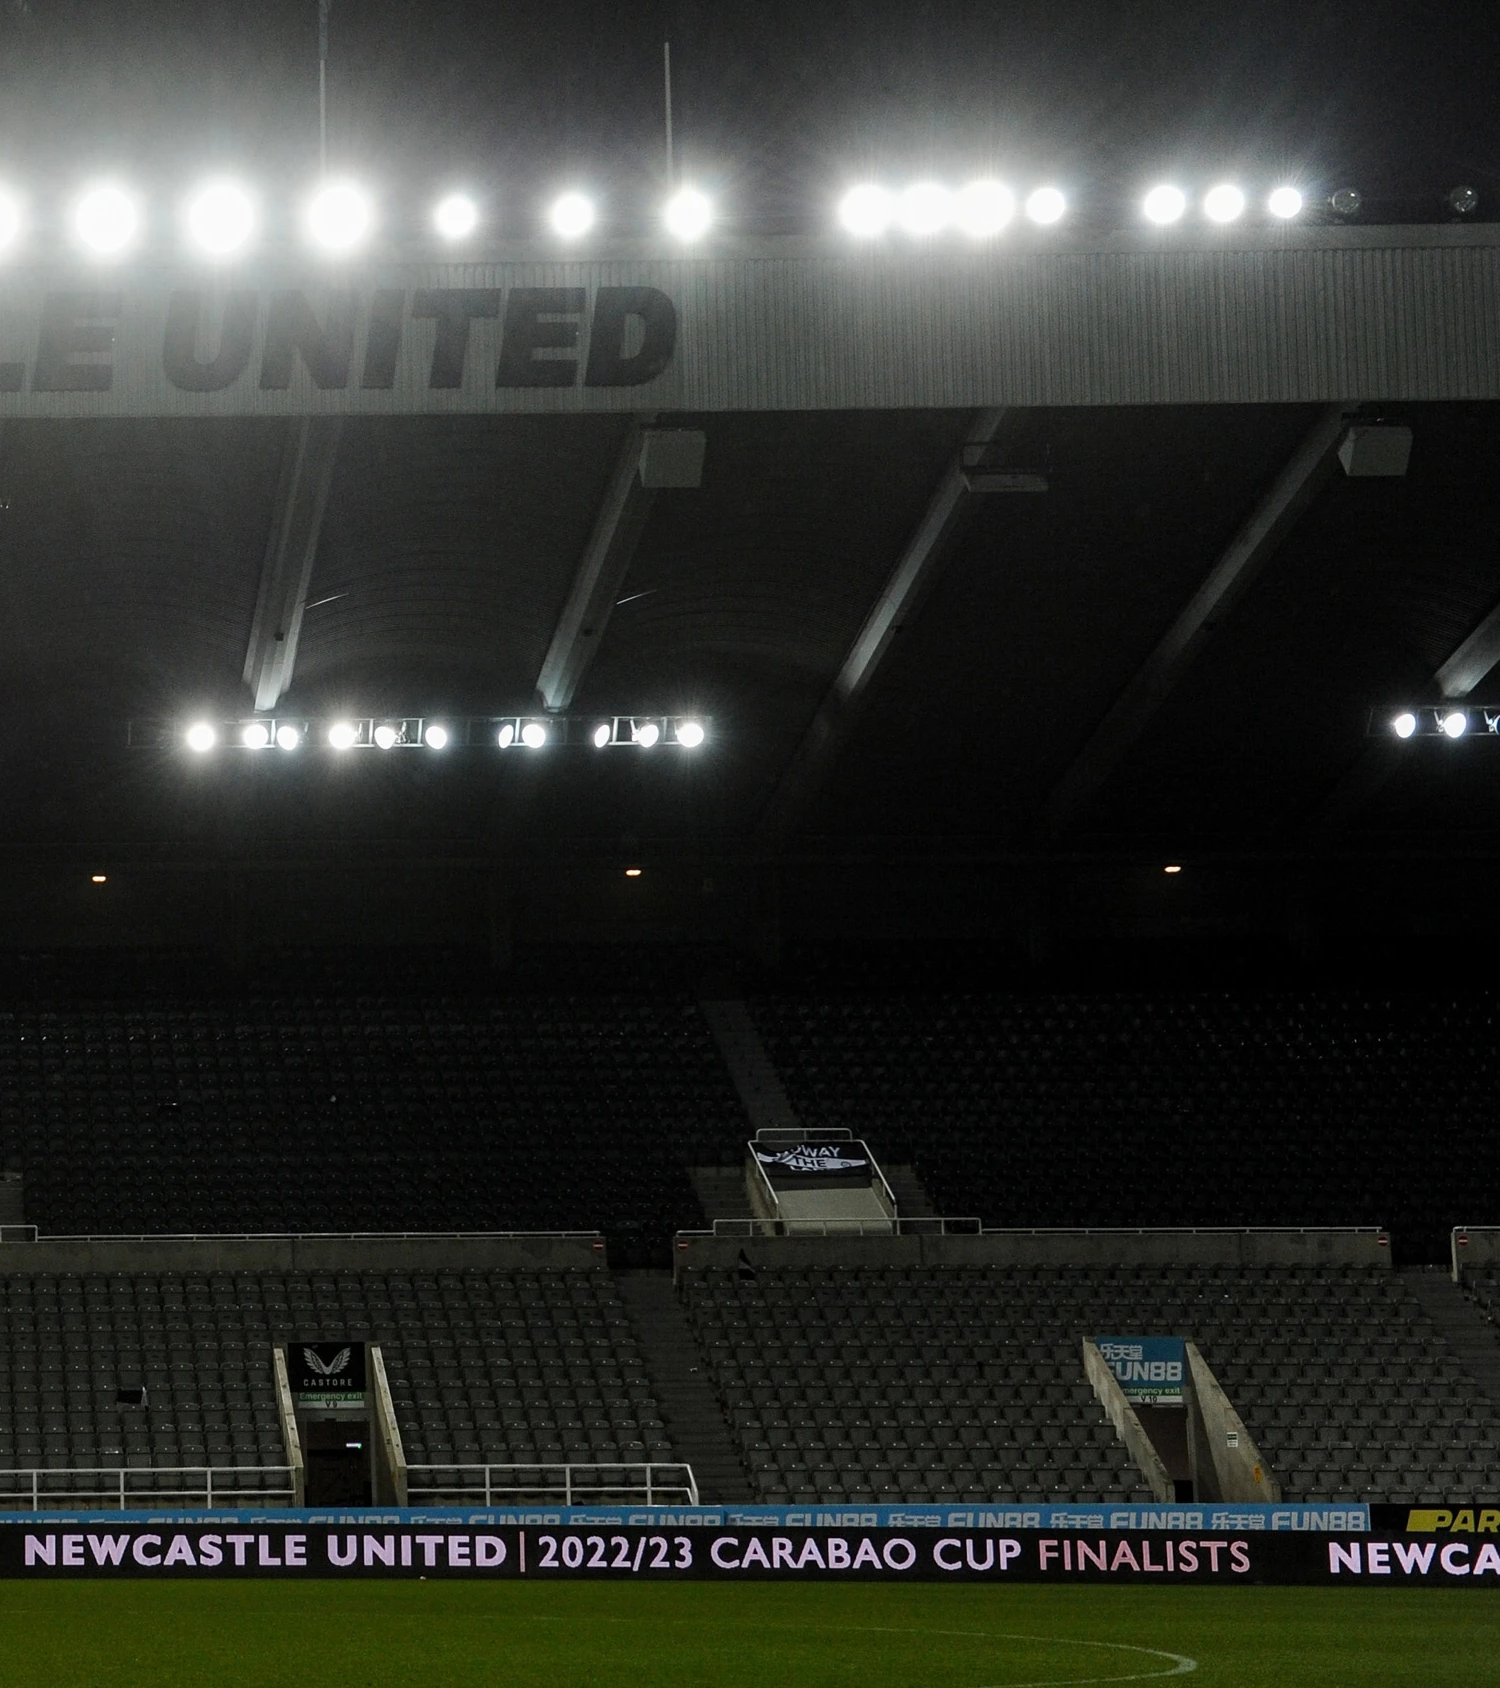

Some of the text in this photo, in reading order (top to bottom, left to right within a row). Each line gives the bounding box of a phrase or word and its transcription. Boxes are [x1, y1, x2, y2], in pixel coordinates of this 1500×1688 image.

[161, 286, 678, 393] UNITED
[793, 1155, 827, 1168] THE
[1107, 1361, 1182, 1381] UN88
[303, 1378, 354, 1387] CASTORE
[300, 1391, 363, 1401] Emergency exit
[1271, 1511, 1365, 1532] FUN88
[24, 1534, 1251, 1573] NEWCASTLE UNITED 2022/23 CARABAO CUP FINALISTS
[1329, 1542, 1500, 1576] NEWCA
